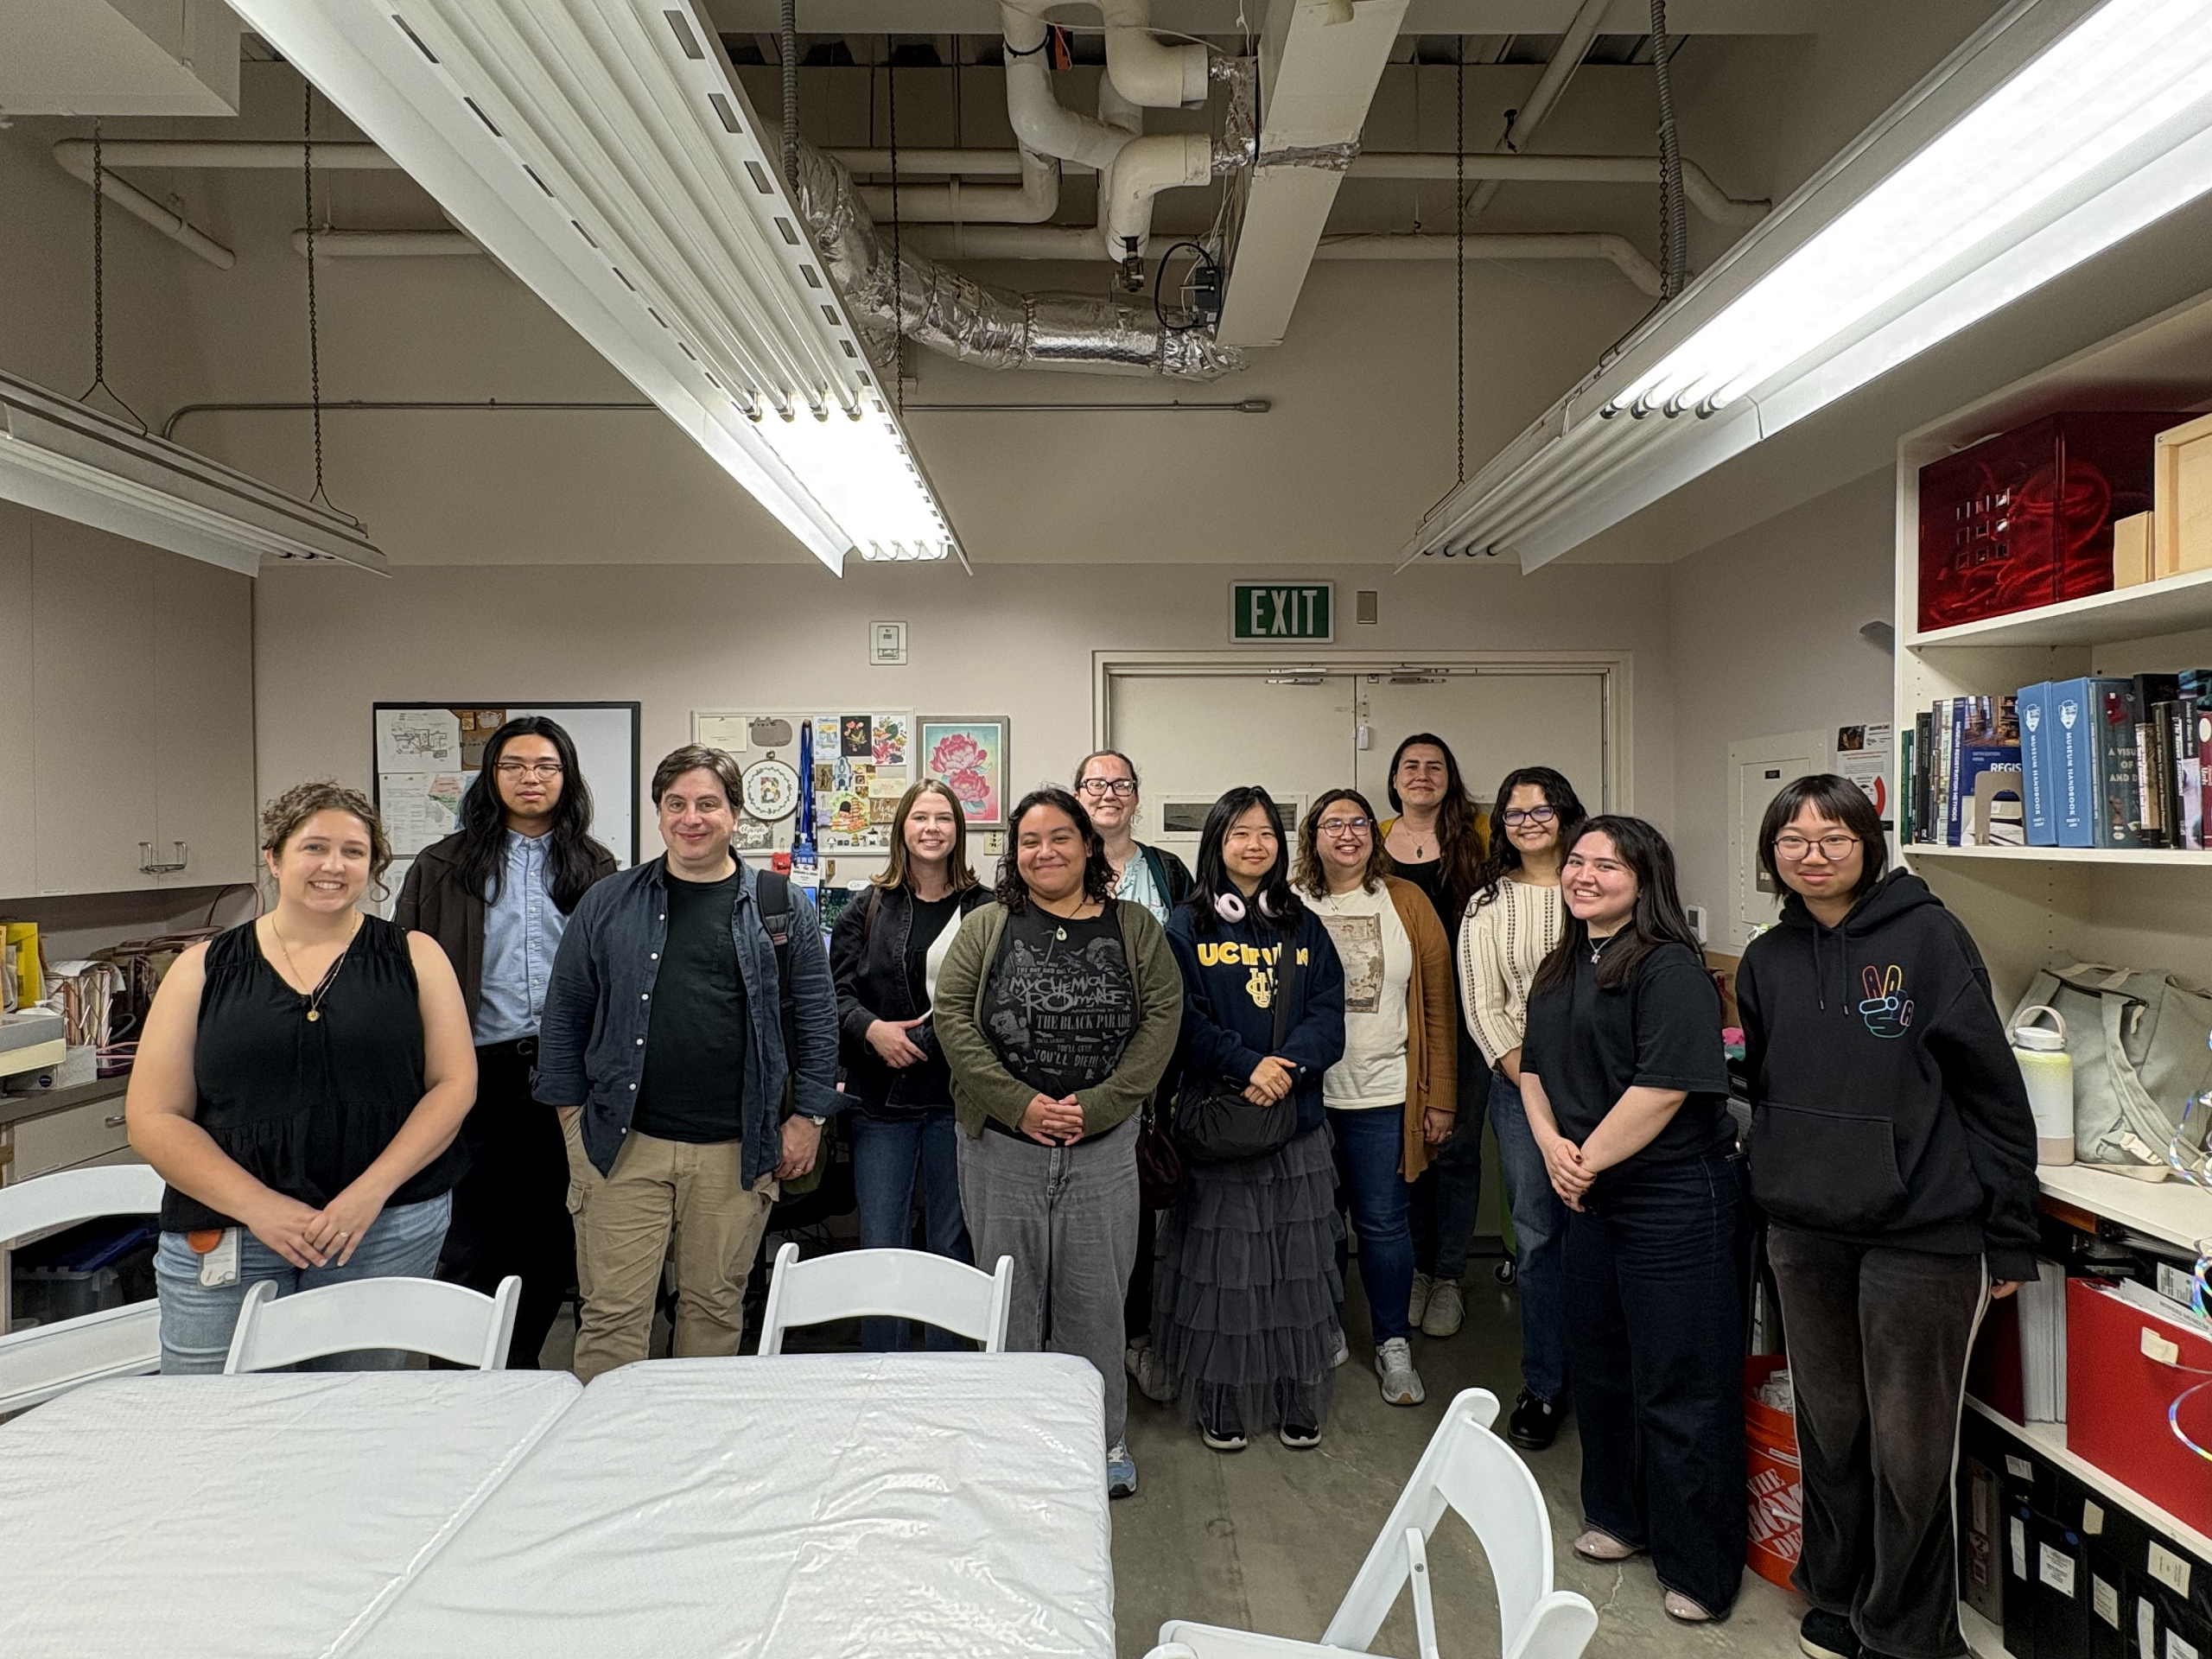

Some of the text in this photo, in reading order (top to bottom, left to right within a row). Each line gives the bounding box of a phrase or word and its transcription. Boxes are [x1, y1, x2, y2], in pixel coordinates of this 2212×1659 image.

[1251, 589, 1318, 635] EXIT
[2108, 747, 2115, 756] A
[2120, 760, 2133, 769] OF
[2109, 773, 2129, 782] AND
[760, 777, 780, 804] B
[2032, 770, 2041, 815] HANDBOOK
[2067, 768, 2075, 815] HANDBOOK
[1034, 973, 1121, 998] CHEMICAL
[1021, 987, 1126, 1023] ROMANCE
[1037, 1014, 1132, 1030] THE BLACK PARADE
[1033, 1048, 1069, 1066] YOU'LL
